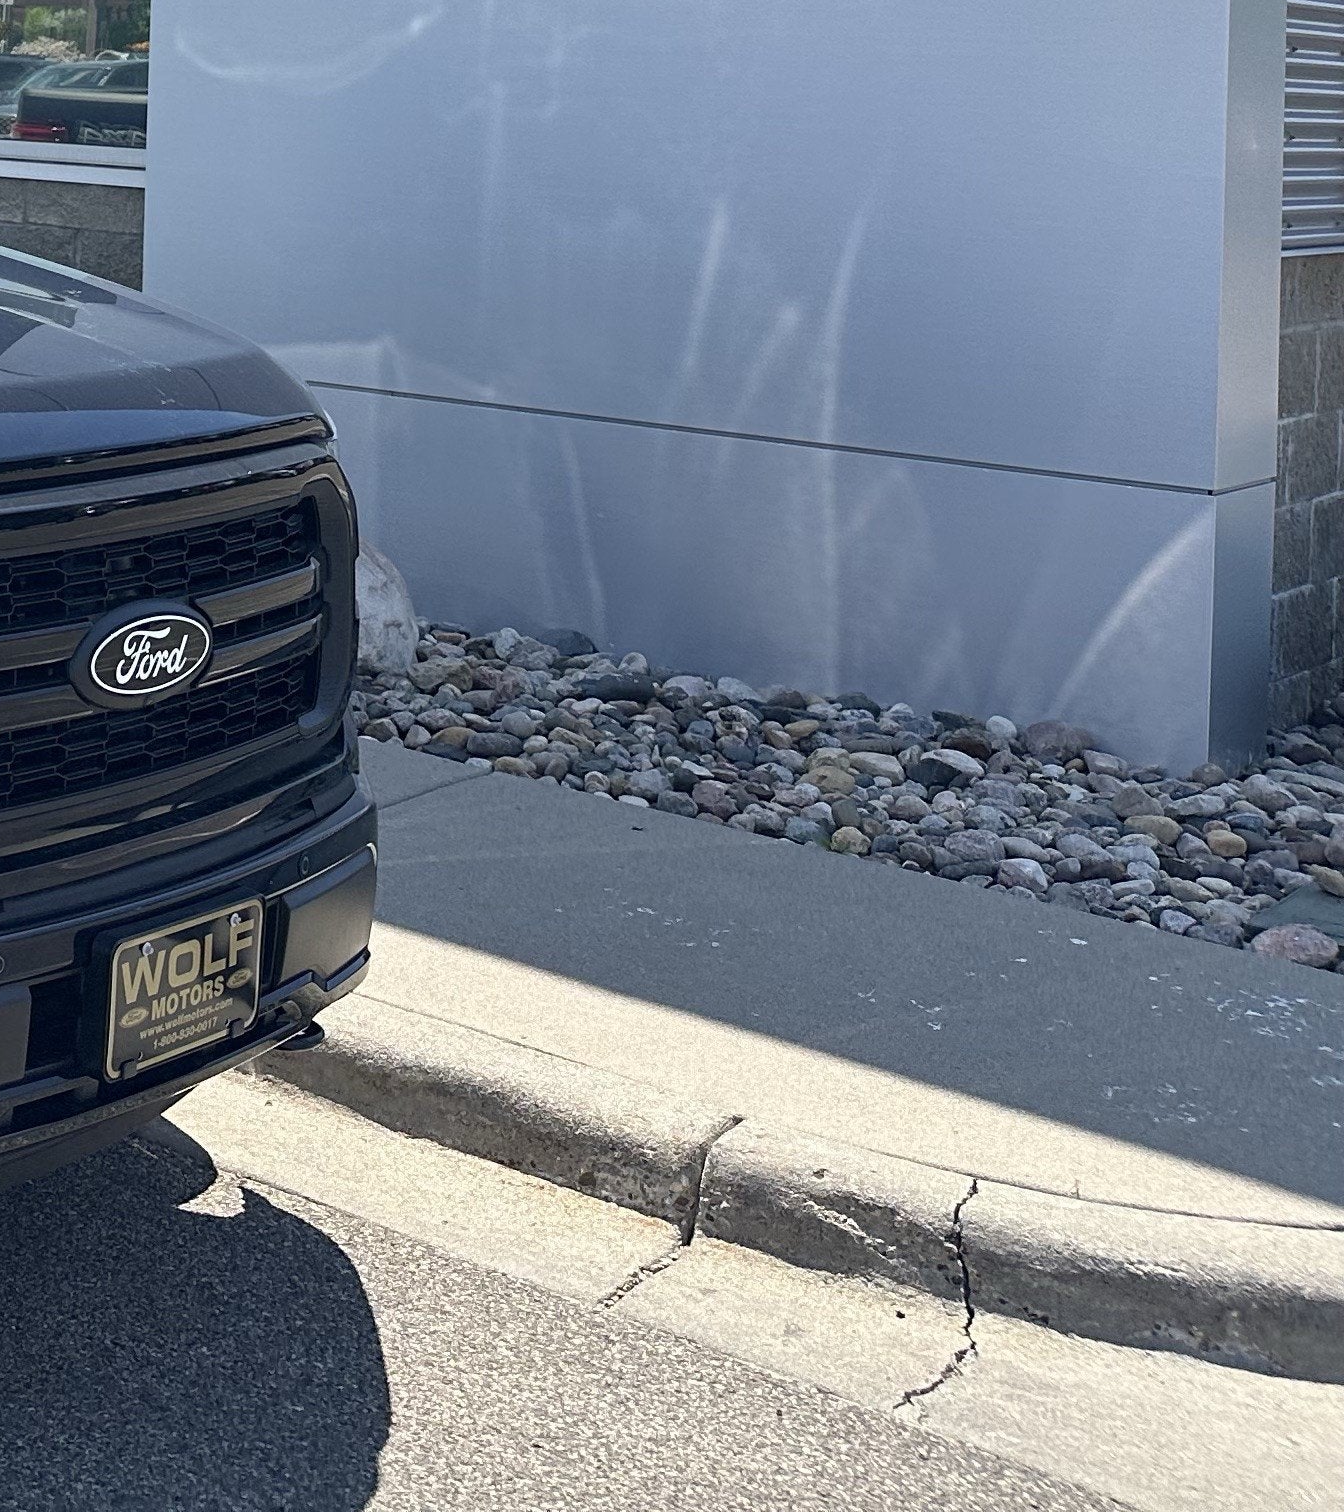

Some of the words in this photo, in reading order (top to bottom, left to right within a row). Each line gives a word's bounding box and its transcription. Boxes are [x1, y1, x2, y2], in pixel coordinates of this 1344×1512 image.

[116, 626, 188, 684] Ford
[122, 919, 254, 1004] WOLF
[140, 998, 233, 1039] www.wolfmotors.com
[152, 975, 224, 1020] MOTORS
